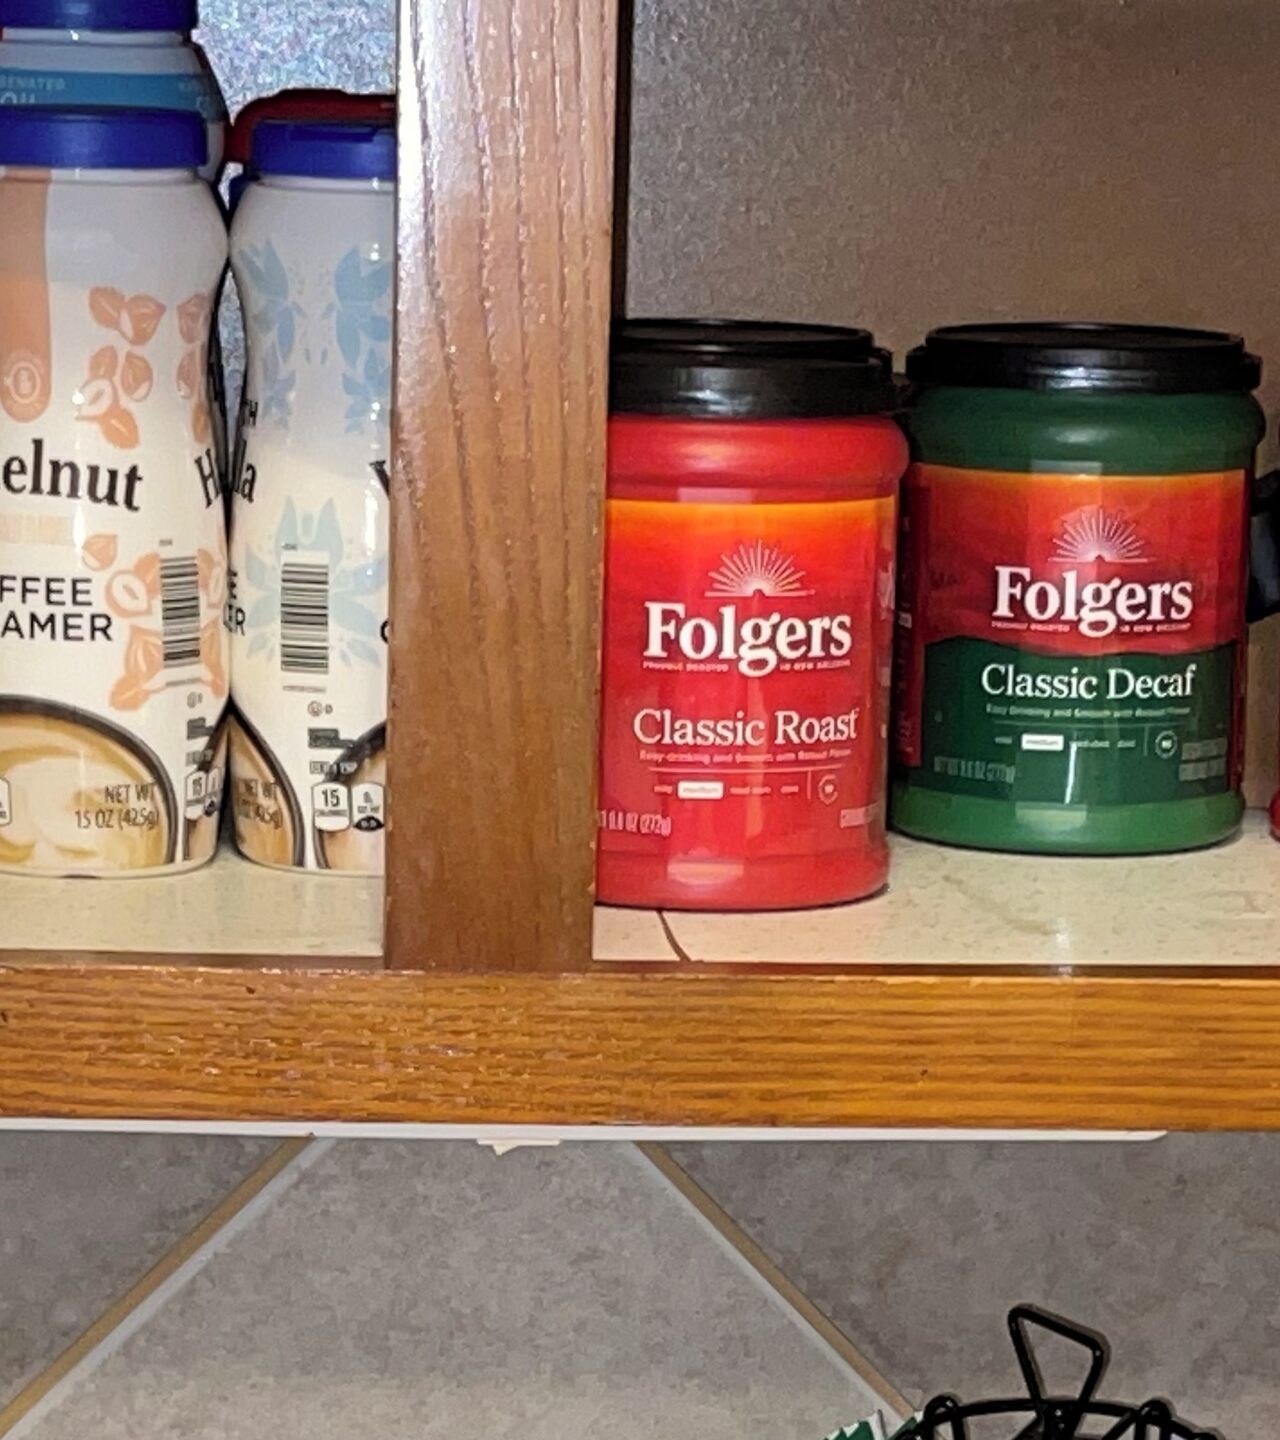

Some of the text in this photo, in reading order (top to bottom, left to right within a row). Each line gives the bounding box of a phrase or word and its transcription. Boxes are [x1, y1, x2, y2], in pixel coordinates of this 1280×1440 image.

[992, 564, 1193, 638] Folgers
[642, 600, 853, 678] Folgers
[981, 663, 1198, 700] Classic Decaf
[633, 707, 859, 747] Classic Roast
[105, 784, 129, 803] NET
[322, 788, 341, 807] 15
[76, 811, 91, 828] 15
[95, 810, 114, 829] OZ
